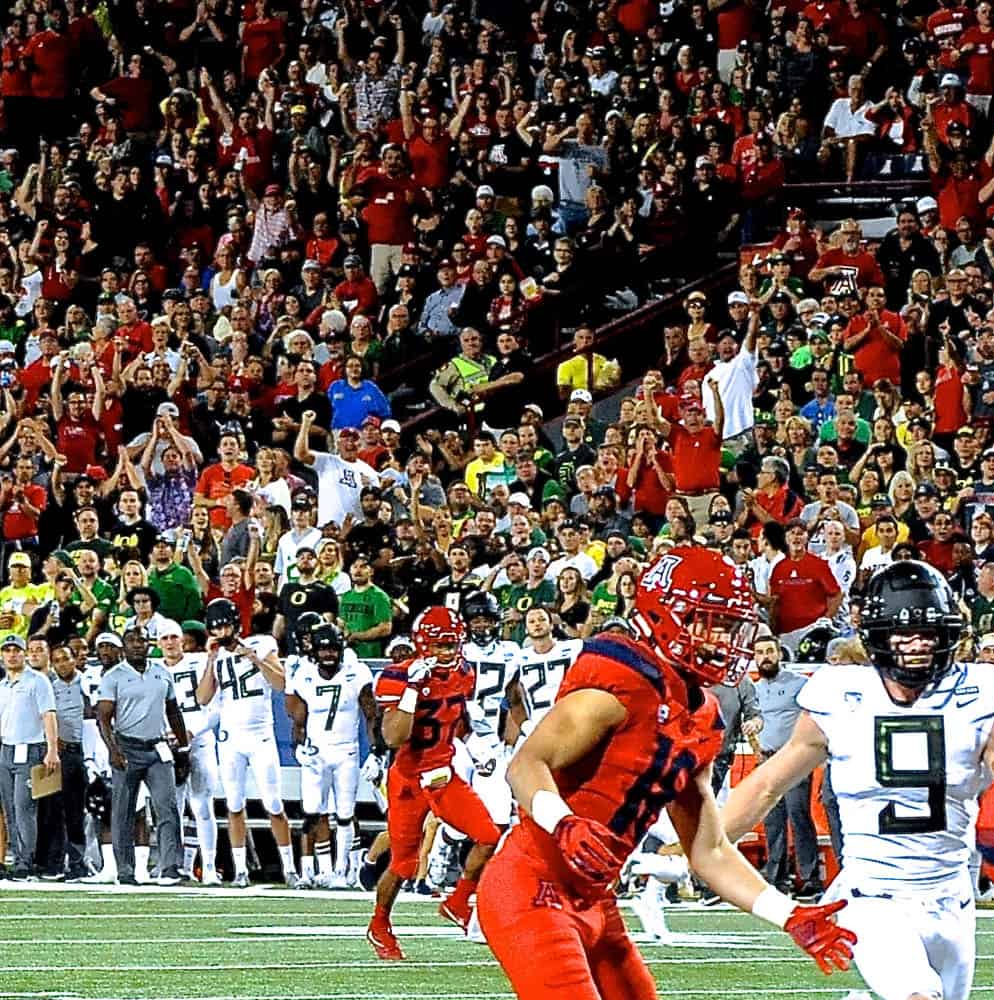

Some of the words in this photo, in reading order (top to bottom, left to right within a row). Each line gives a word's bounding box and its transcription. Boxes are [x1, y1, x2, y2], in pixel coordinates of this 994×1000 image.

[291, 590, 307, 606] O
[641, 555, 684, 598] A
[516, 595, 533, 613] O
[174, 670, 201, 713] 3
[217, 653, 264, 700] 42
[522, 657, 571, 710] 27
[316, 684, 341, 731] 7
[874, 714, 946, 835] 9
